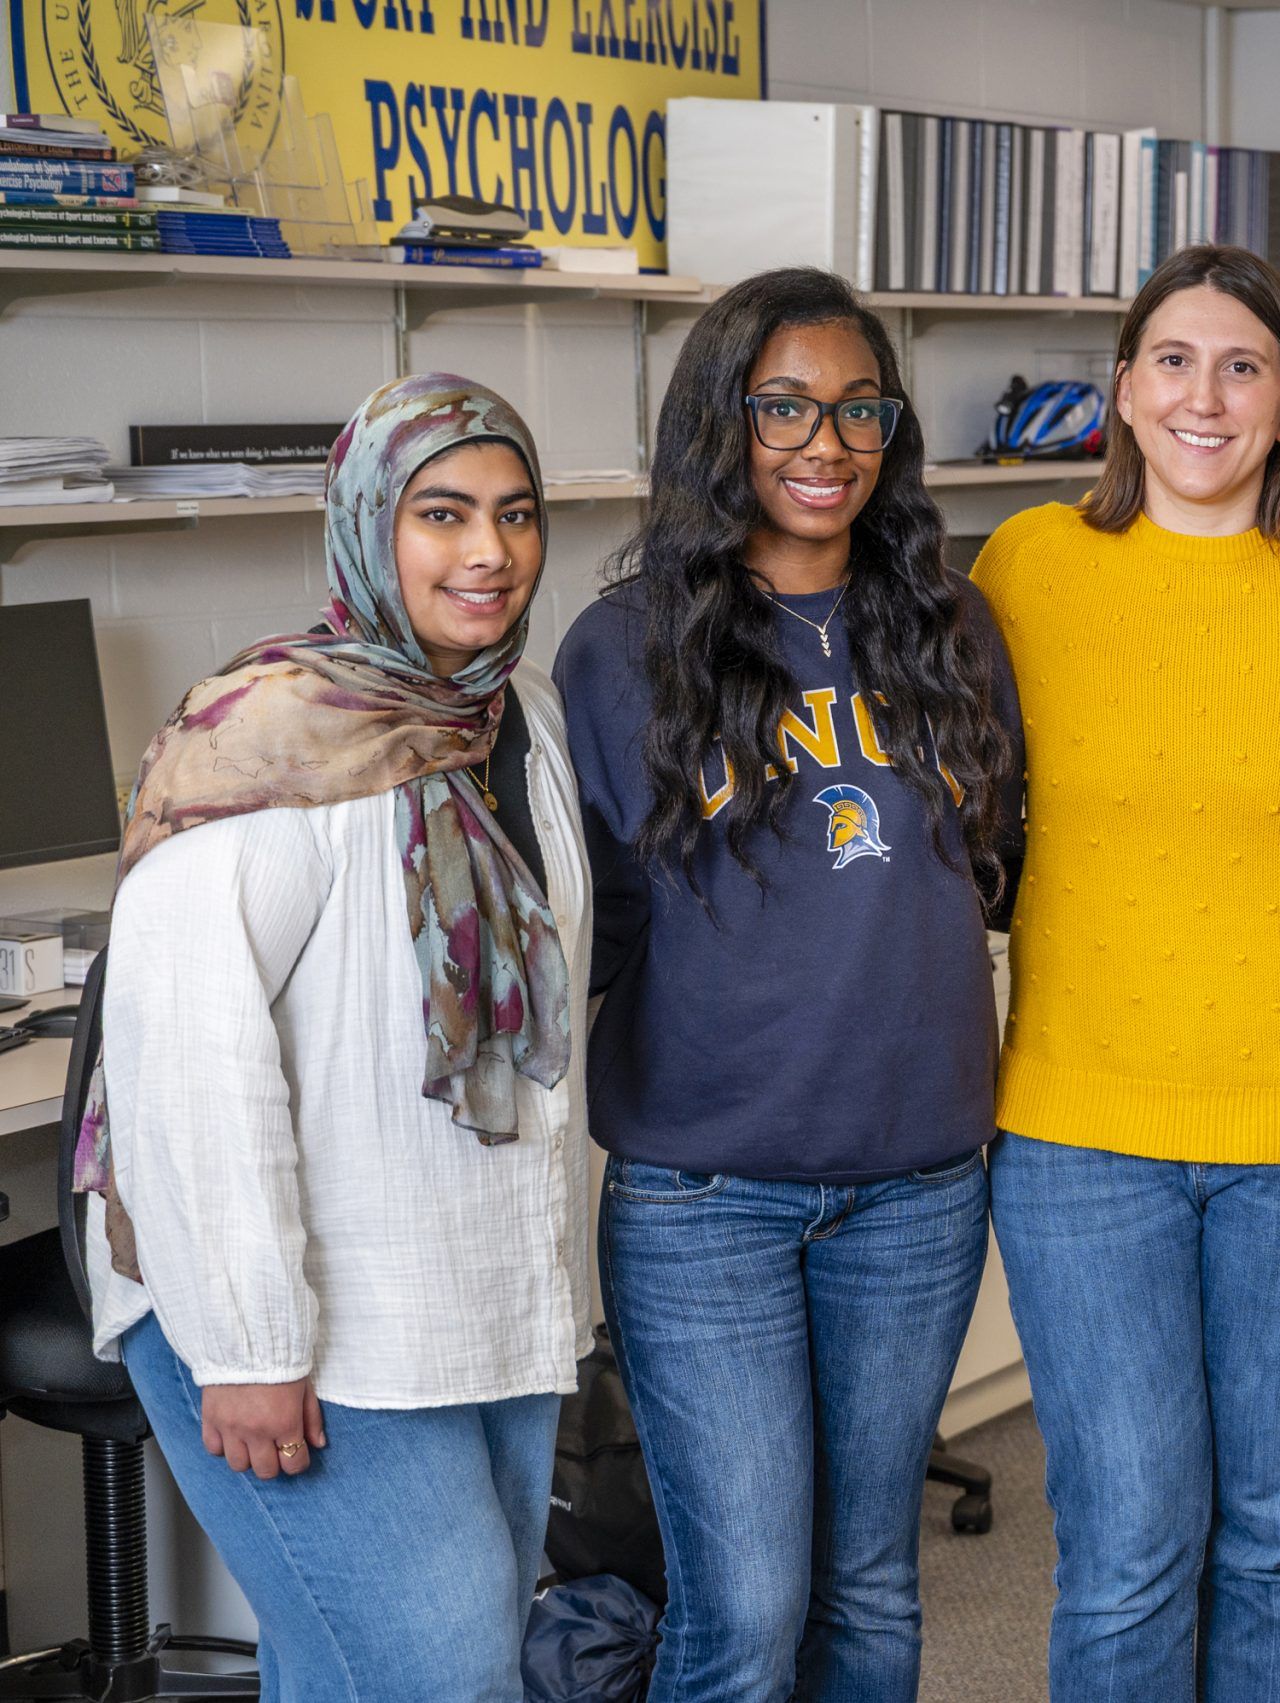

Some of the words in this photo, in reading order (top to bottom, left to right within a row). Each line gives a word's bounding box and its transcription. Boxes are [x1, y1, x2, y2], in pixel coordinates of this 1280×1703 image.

[59, 49, 87, 111] THE
[24, 174, 63, 193] Psychology
[188, 448, 204, 459] knew
[206, 448, 221, 459] what
[699, 686, 965, 820] UNC
